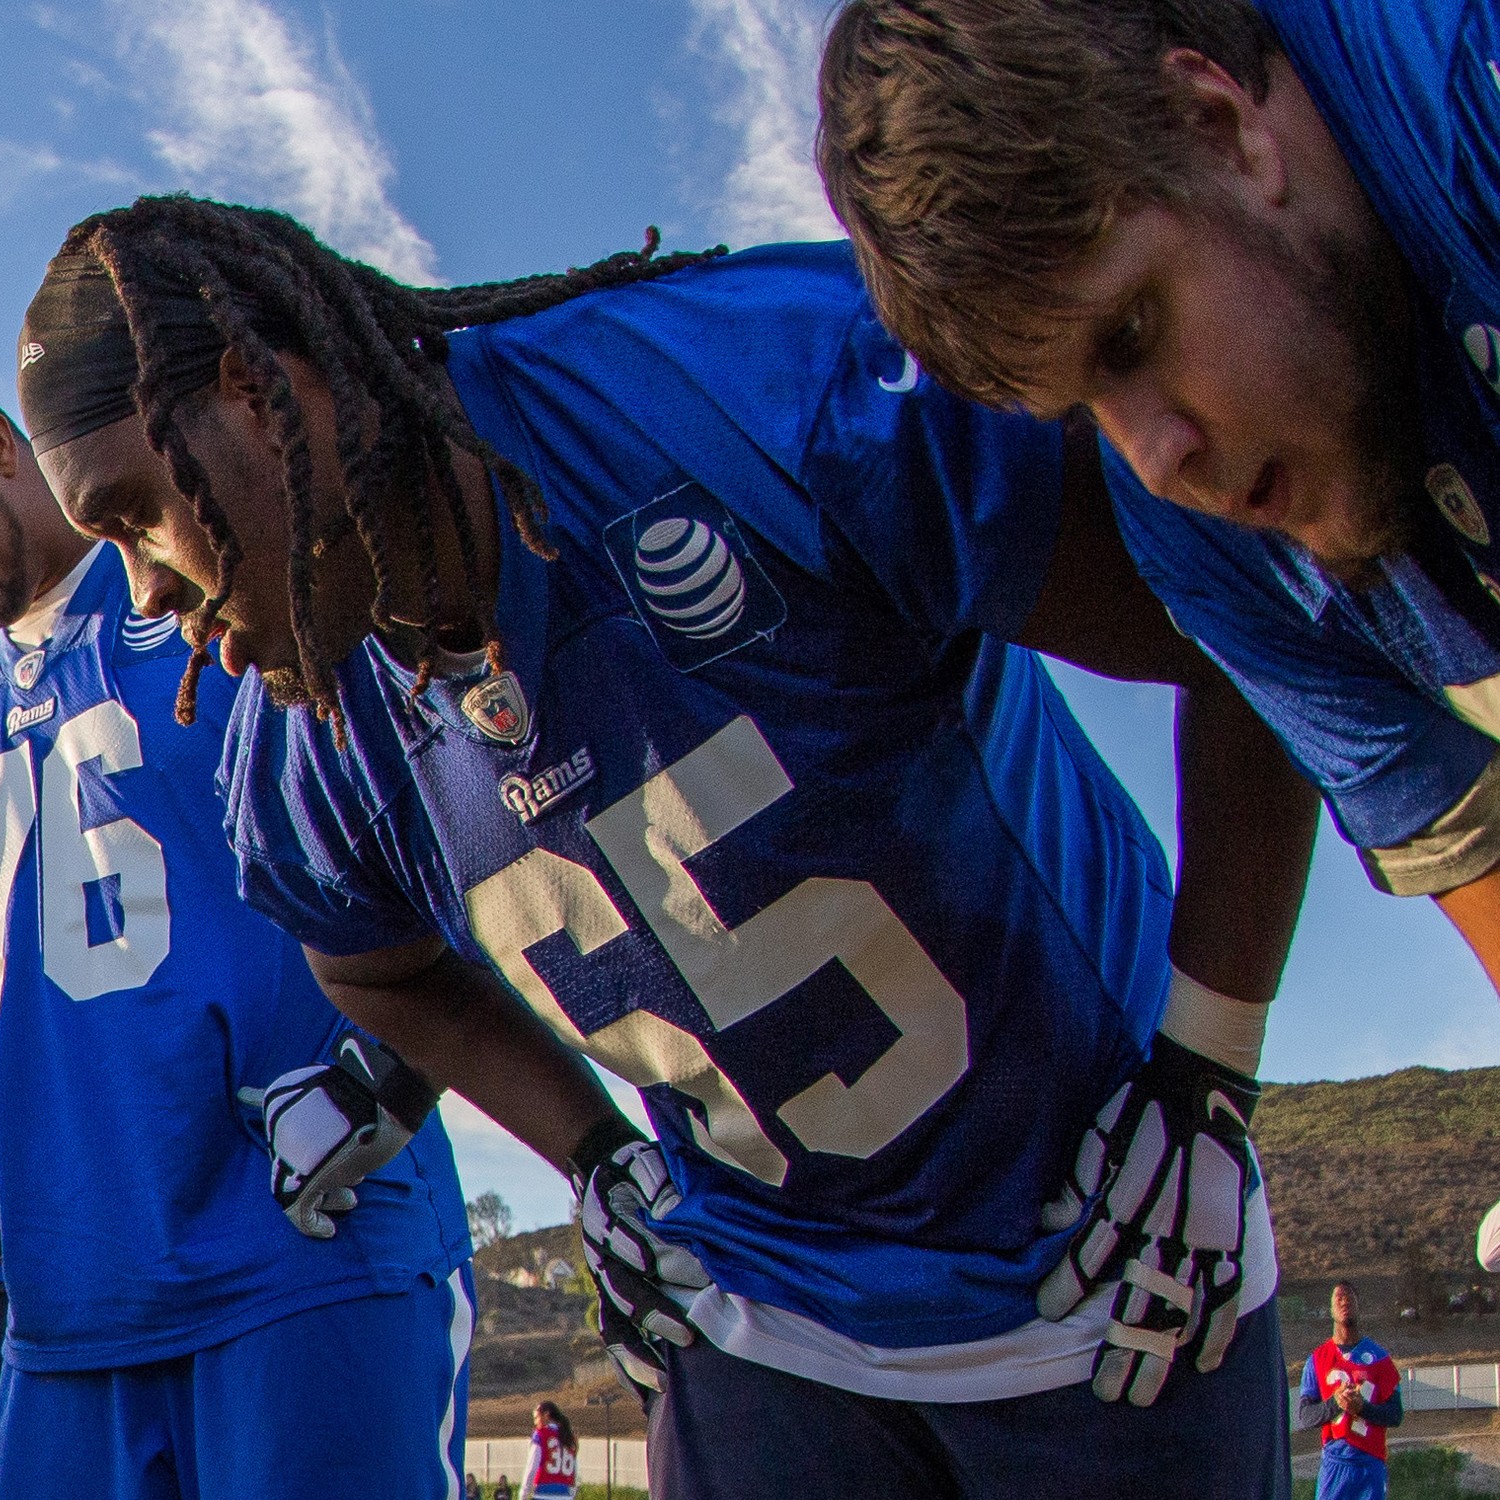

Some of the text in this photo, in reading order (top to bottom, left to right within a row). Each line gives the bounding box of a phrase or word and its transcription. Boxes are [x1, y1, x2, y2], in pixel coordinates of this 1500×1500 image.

[7, 696, 56, 737] Rams
[501, 748, 595, 822] Rams
[465, 715, 969, 1187] 65
